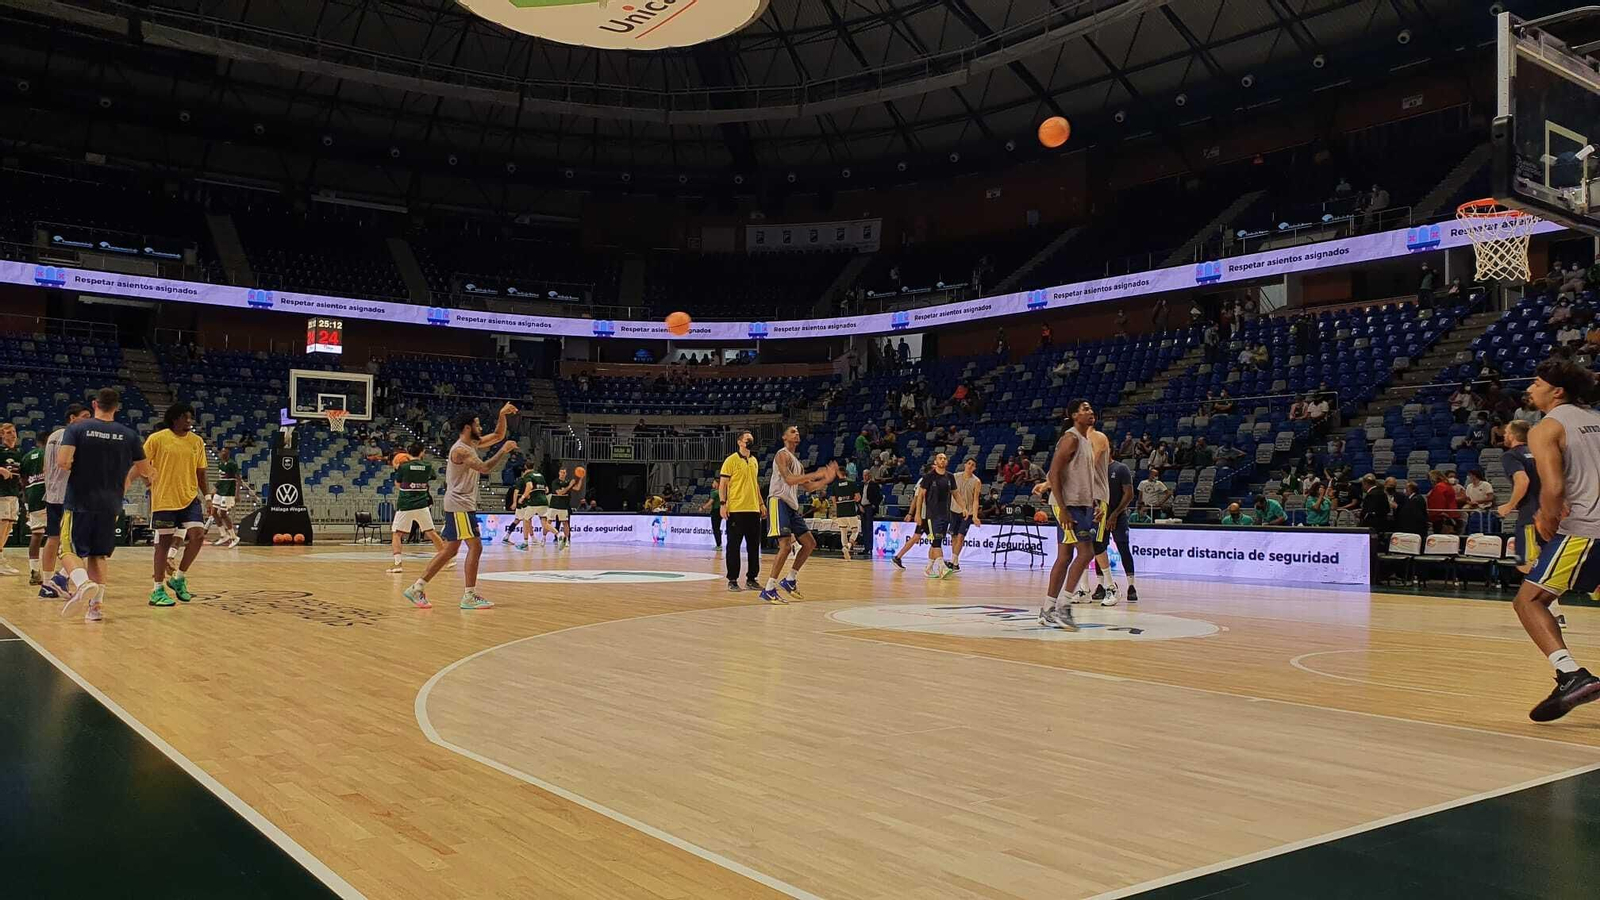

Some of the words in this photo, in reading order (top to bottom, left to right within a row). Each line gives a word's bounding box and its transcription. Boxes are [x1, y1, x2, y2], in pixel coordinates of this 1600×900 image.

[1228, 261, 1265, 272] Respetar
[1267, 255, 1302, 266] asientos
[1304, 247, 1349, 260] asignados
[75, 275, 114, 287] Respetar
[116, 281, 154, 291] asientos
[155, 285, 197, 296] asignados
[1053, 290, 1082, 300] Respetar
[1083, 285, 1112, 295] asientos
[1113, 280, 1149, 291] asignados
[280, 297, 314, 307] Respetar
[316, 301, 347, 310] asientos
[348, 304, 385, 313] asignados
[914, 313, 938, 321] Respetar
[939, 309, 962, 317] asientos
[963, 304, 992, 314] asignados
[318, 319, 343, 330] 25:12
[456, 315, 486, 324] Respetar
[488, 317, 516, 326] asientos
[517, 320, 551, 329] asignados
[827, 322, 857, 330] asignados
[318, 330, 340, 345] 24
[595, 525, 632, 533] seguridad
[671, 527, 692, 535] Respetar
[693, 527, 714, 535] distanci
[983, 539, 994, 549] de
[997, 540, 1042, 553] seguridad
[1132, 545, 1184, 559] Respetar
[1187, 547, 1244, 561] distancia
[1248, 549, 1265, 562] de
[1269, 551, 1340, 566] seguridad
